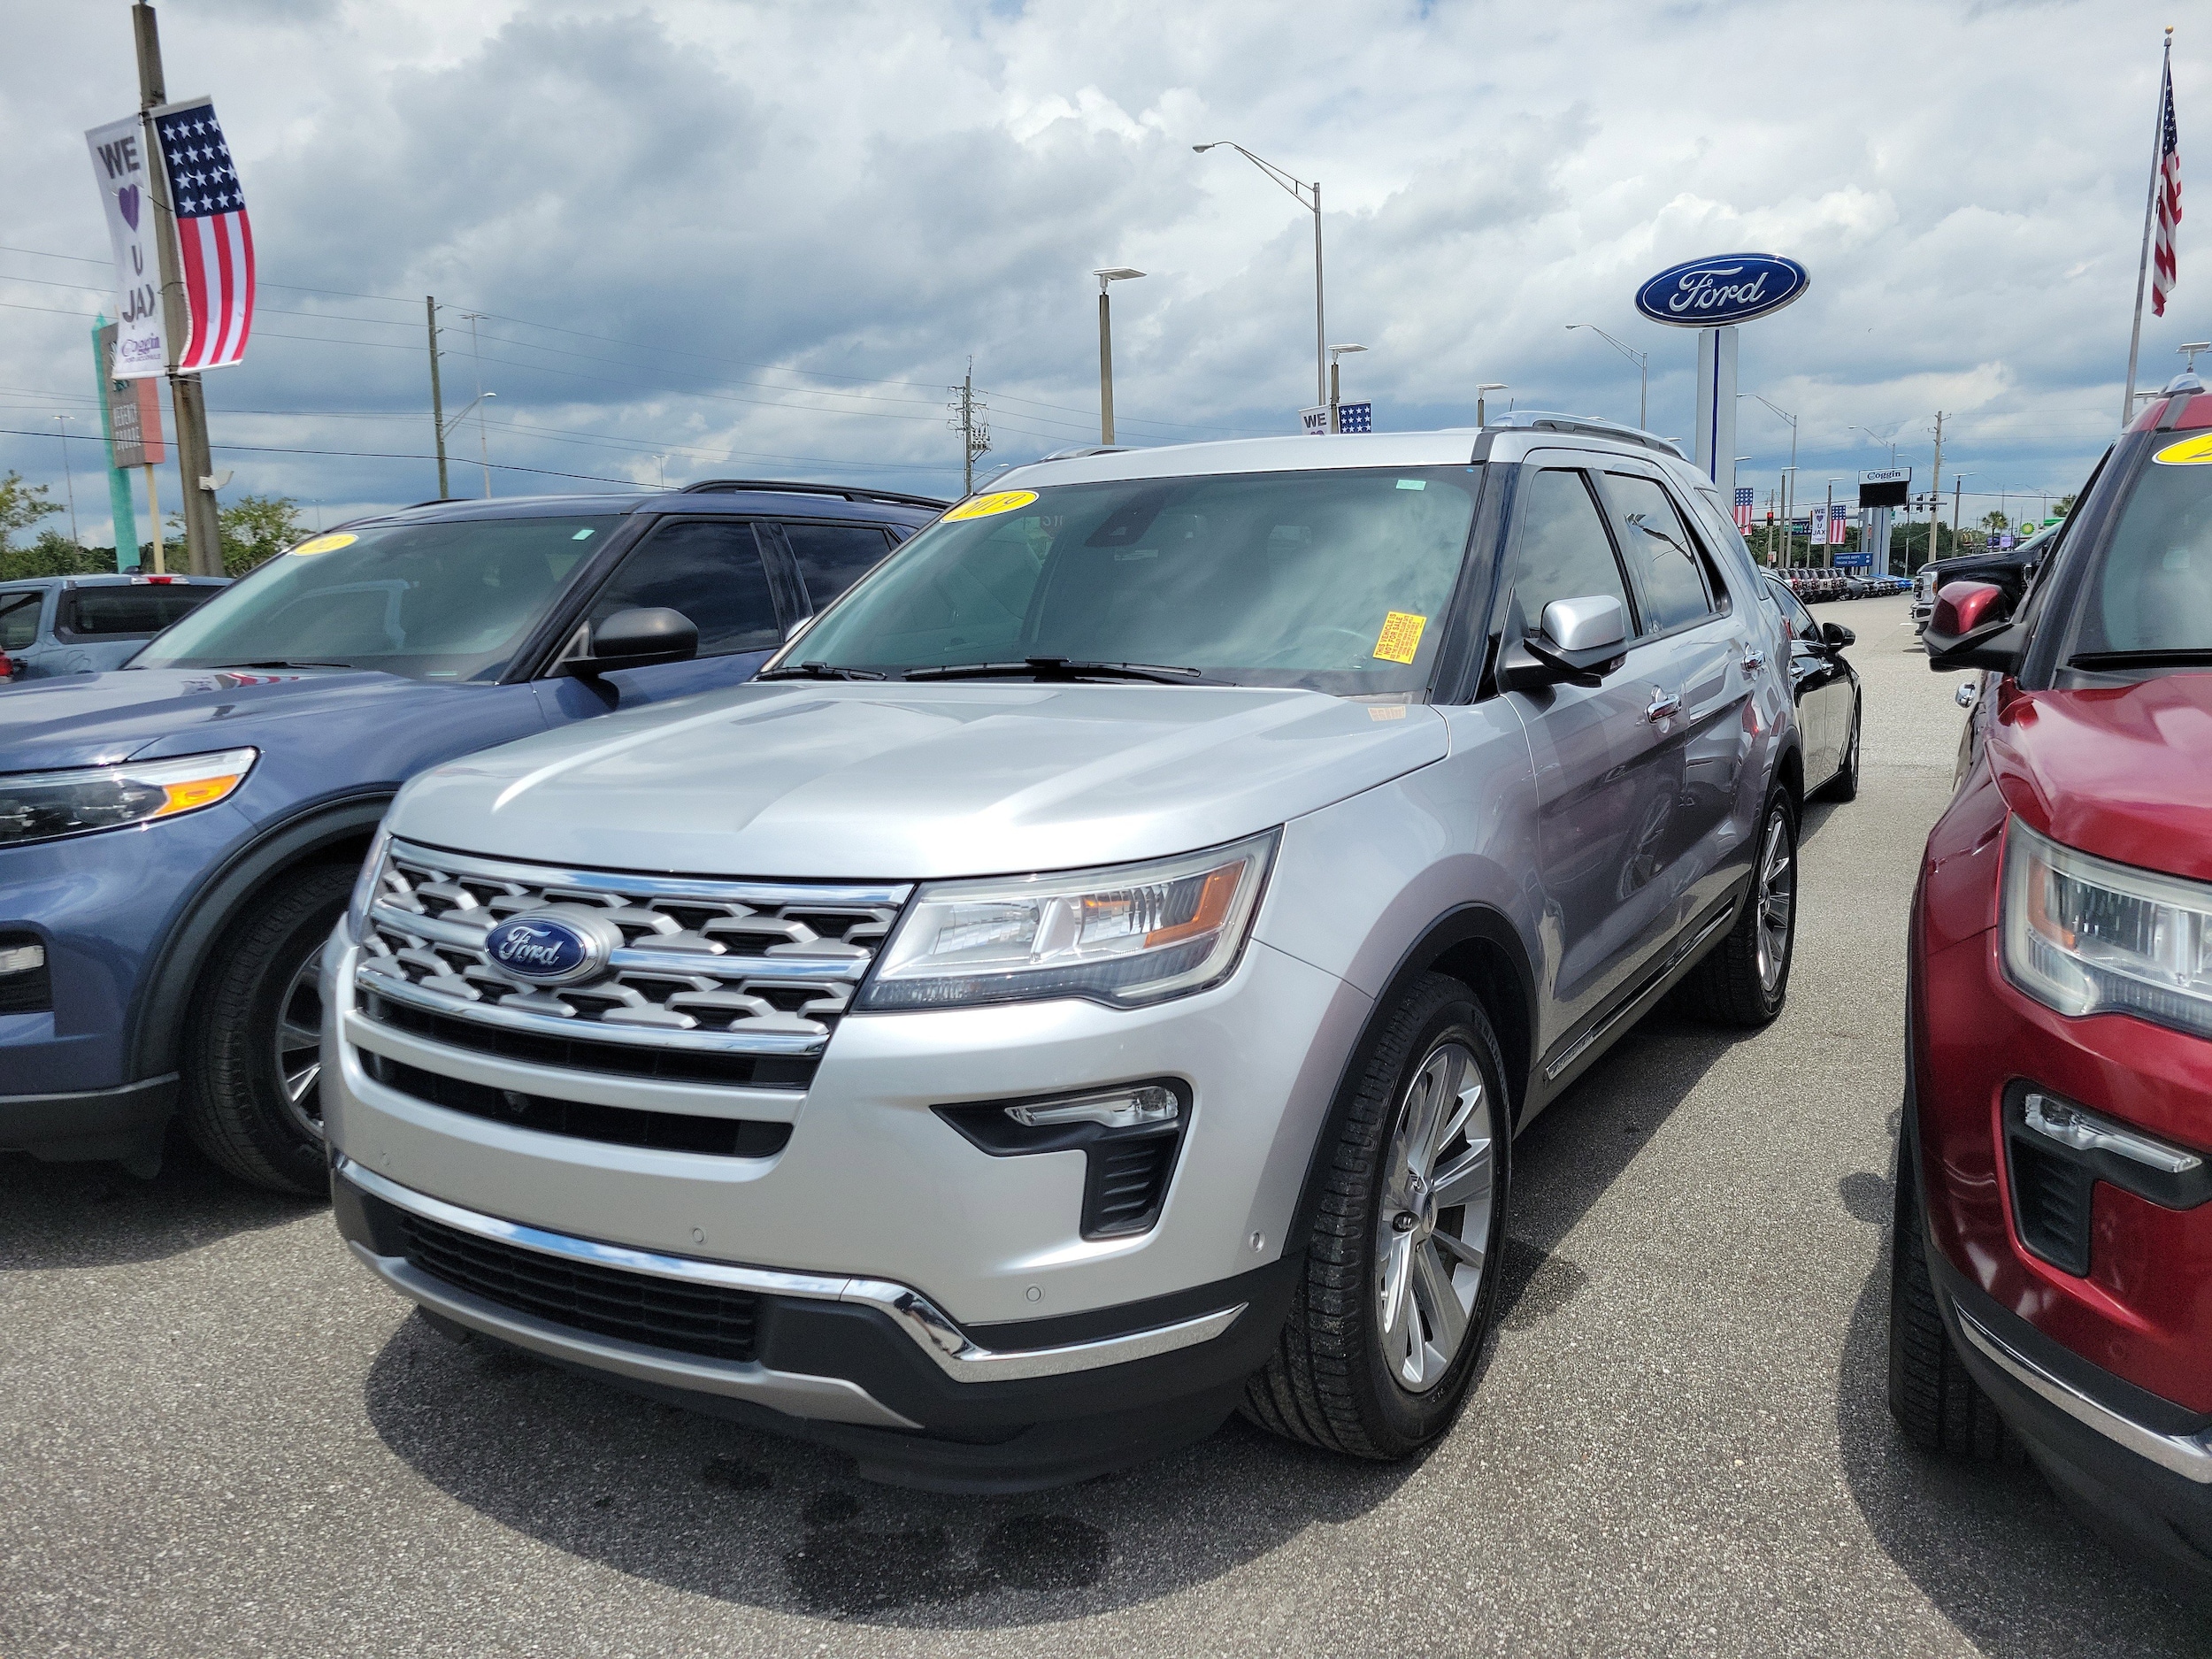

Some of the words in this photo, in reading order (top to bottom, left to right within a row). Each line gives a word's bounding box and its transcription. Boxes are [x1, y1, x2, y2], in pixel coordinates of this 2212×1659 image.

[97, 136, 140, 179] WE
[132, 244, 143, 276] U
[1670, 266, 1769, 311] Ford
[1303, 412, 1327, 428] WE
[1867, 470, 1901, 480] Coggin
[1380, 619, 1394, 642] VEHICLE
[1393, 617, 1402, 630] SALE
[1388, 632, 1397, 642] FOR
[1375, 644, 1386, 656] THIS
[1384, 643, 1394, 655] NOT
[499, 926, 565, 966] Ford
